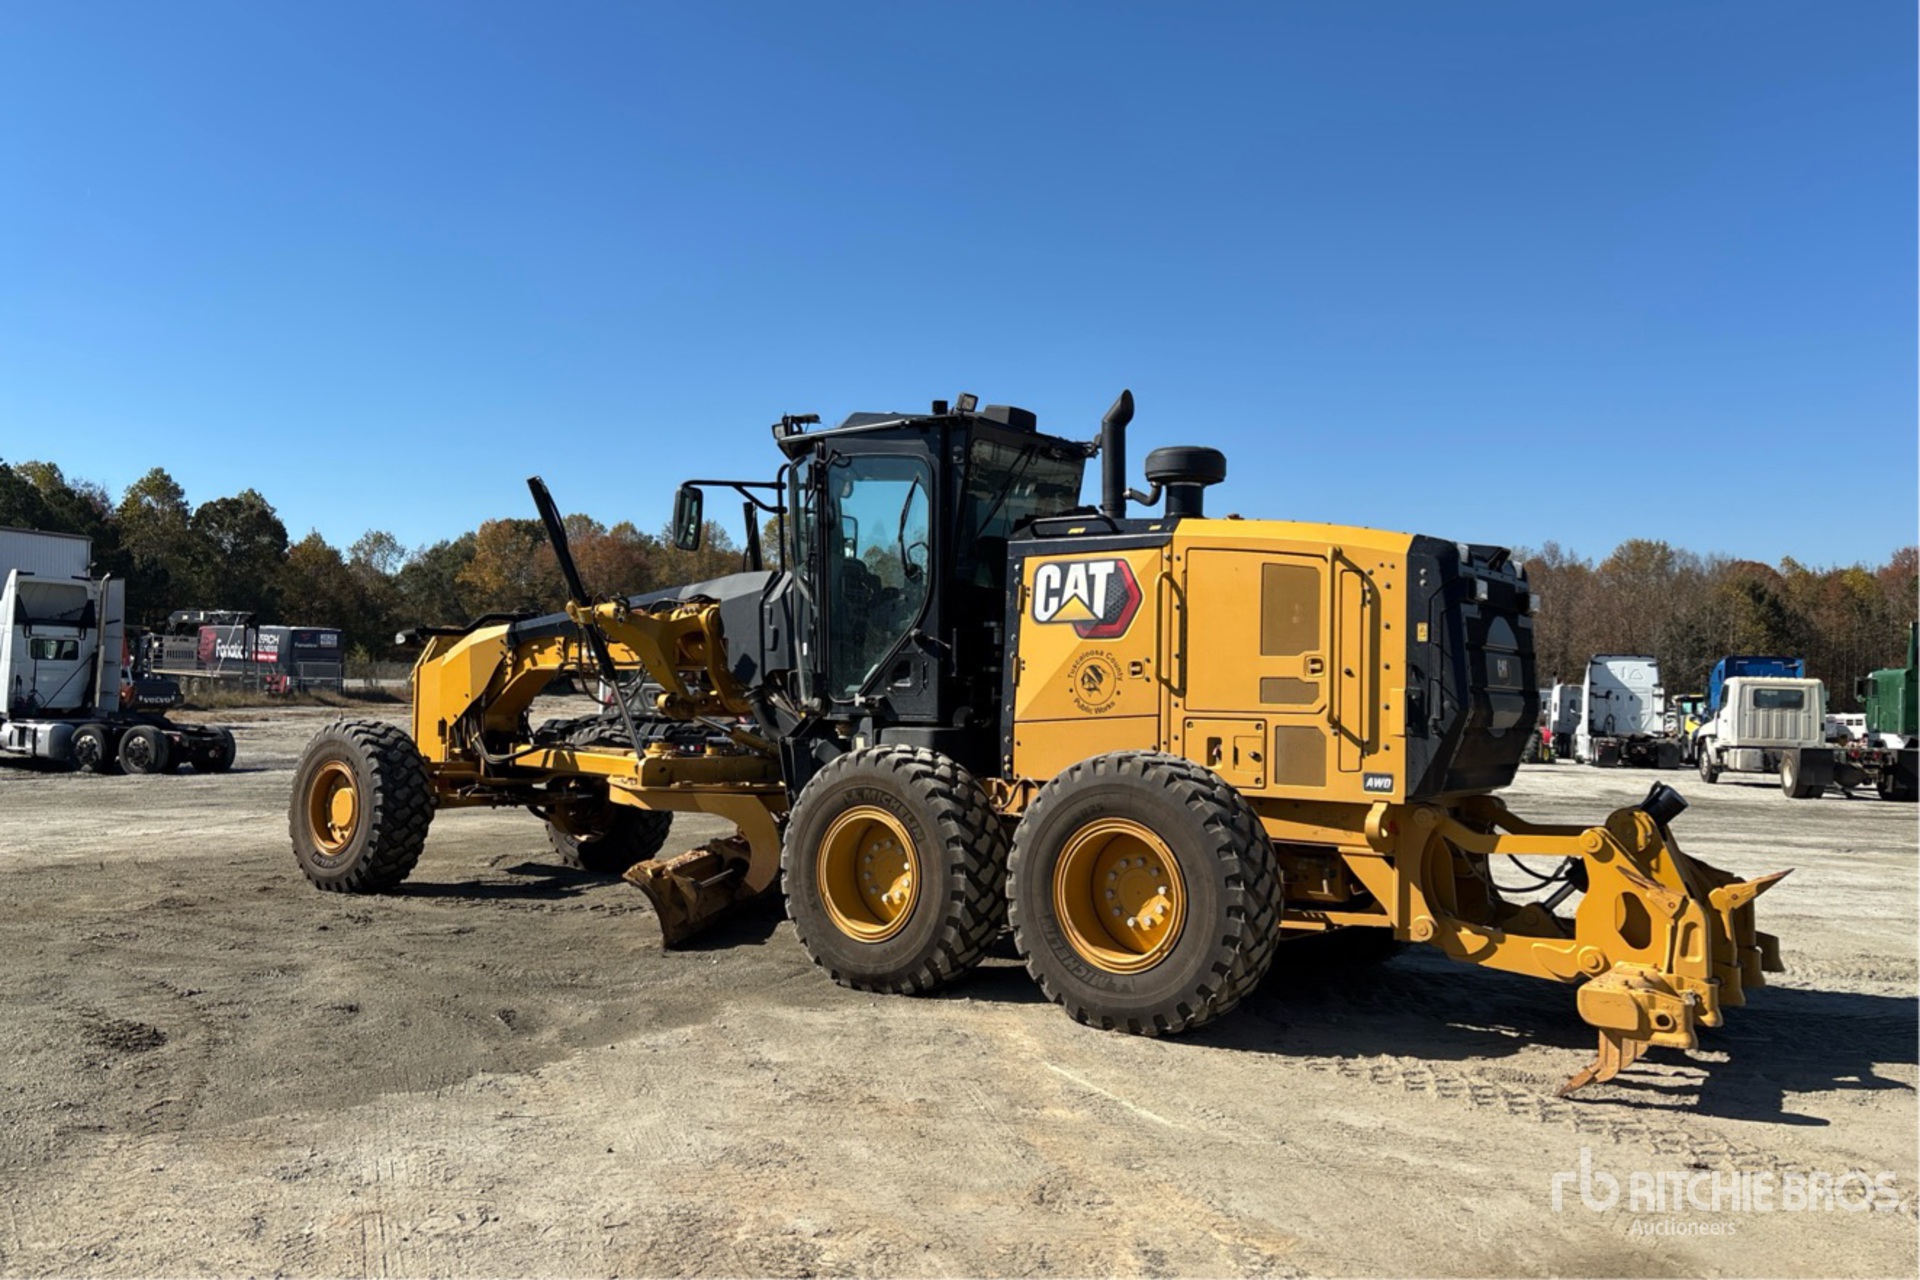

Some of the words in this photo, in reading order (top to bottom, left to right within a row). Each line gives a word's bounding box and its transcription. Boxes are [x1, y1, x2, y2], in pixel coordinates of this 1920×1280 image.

[1034, 561, 1115, 622] CAT
[1067, 650, 1104, 679] Tuscaloosa
[1106, 652, 1124, 681] County
[1074, 697, 1092, 714] Public
[1094, 701, 1115, 714] Works
[1365, 777, 1392, 789] AWD
